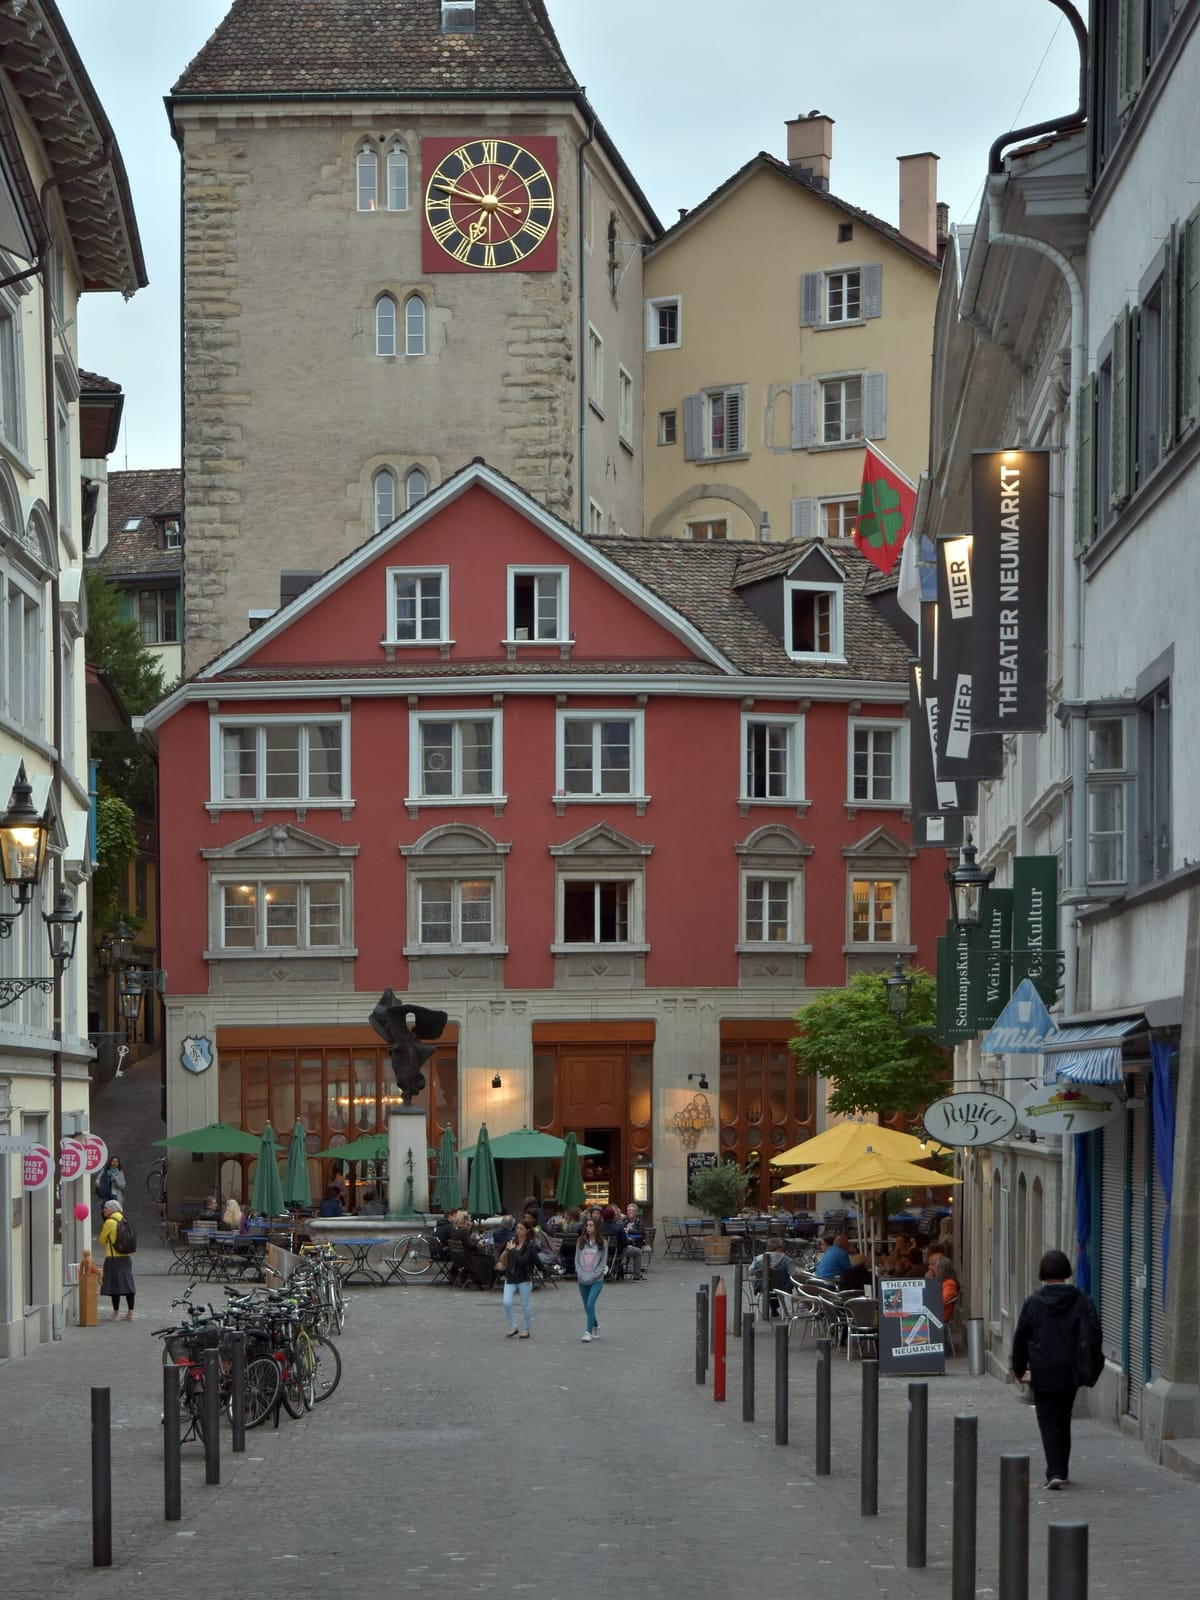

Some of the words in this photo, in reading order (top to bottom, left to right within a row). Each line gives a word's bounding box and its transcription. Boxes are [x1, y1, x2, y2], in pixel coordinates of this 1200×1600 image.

[482, 142, 498, 163] XII
[1000, 465, 1021, 601] NEUMARKT
[951, 560, 970, 609] HIER
[998, 608, 1020, 718] THEATER
[953, 683, 972, 732] HIER
[1063, 1113, 1075, 1131] 7
[895, 1345, 941, 1354] NEUMARKT
